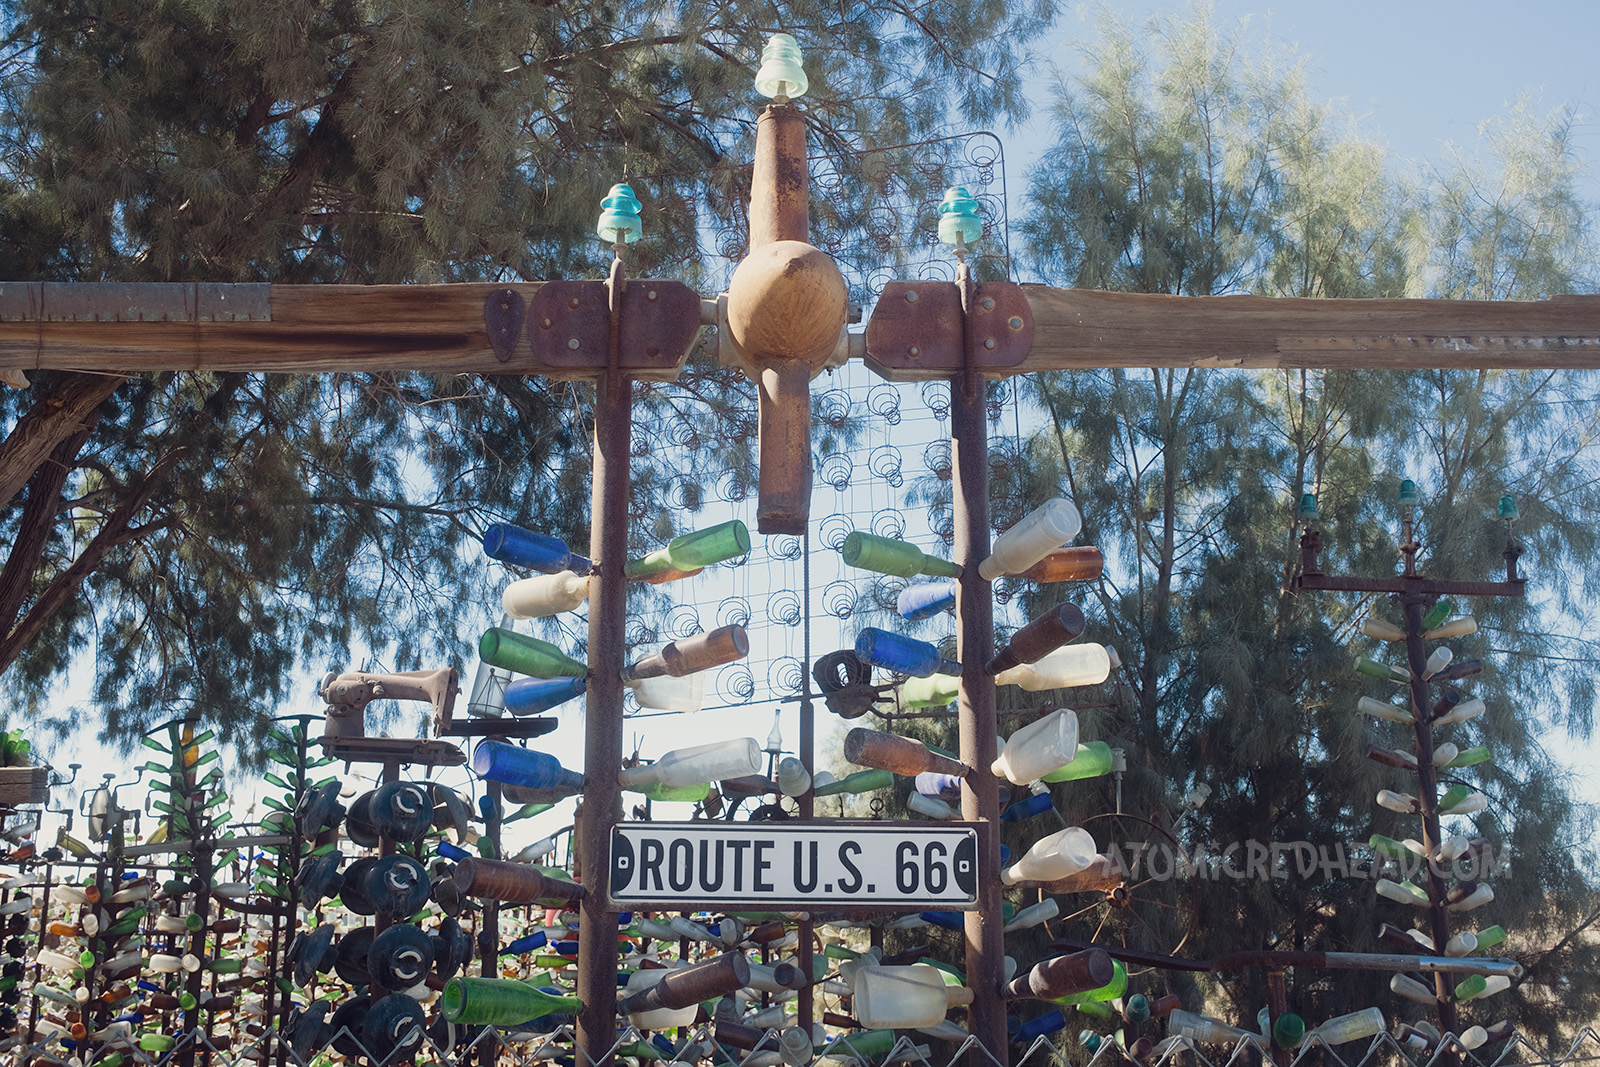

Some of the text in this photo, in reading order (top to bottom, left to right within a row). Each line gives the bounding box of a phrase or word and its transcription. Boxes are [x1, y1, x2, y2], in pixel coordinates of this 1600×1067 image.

[639, 838, 948, 895] ROUTE U.S. 66
